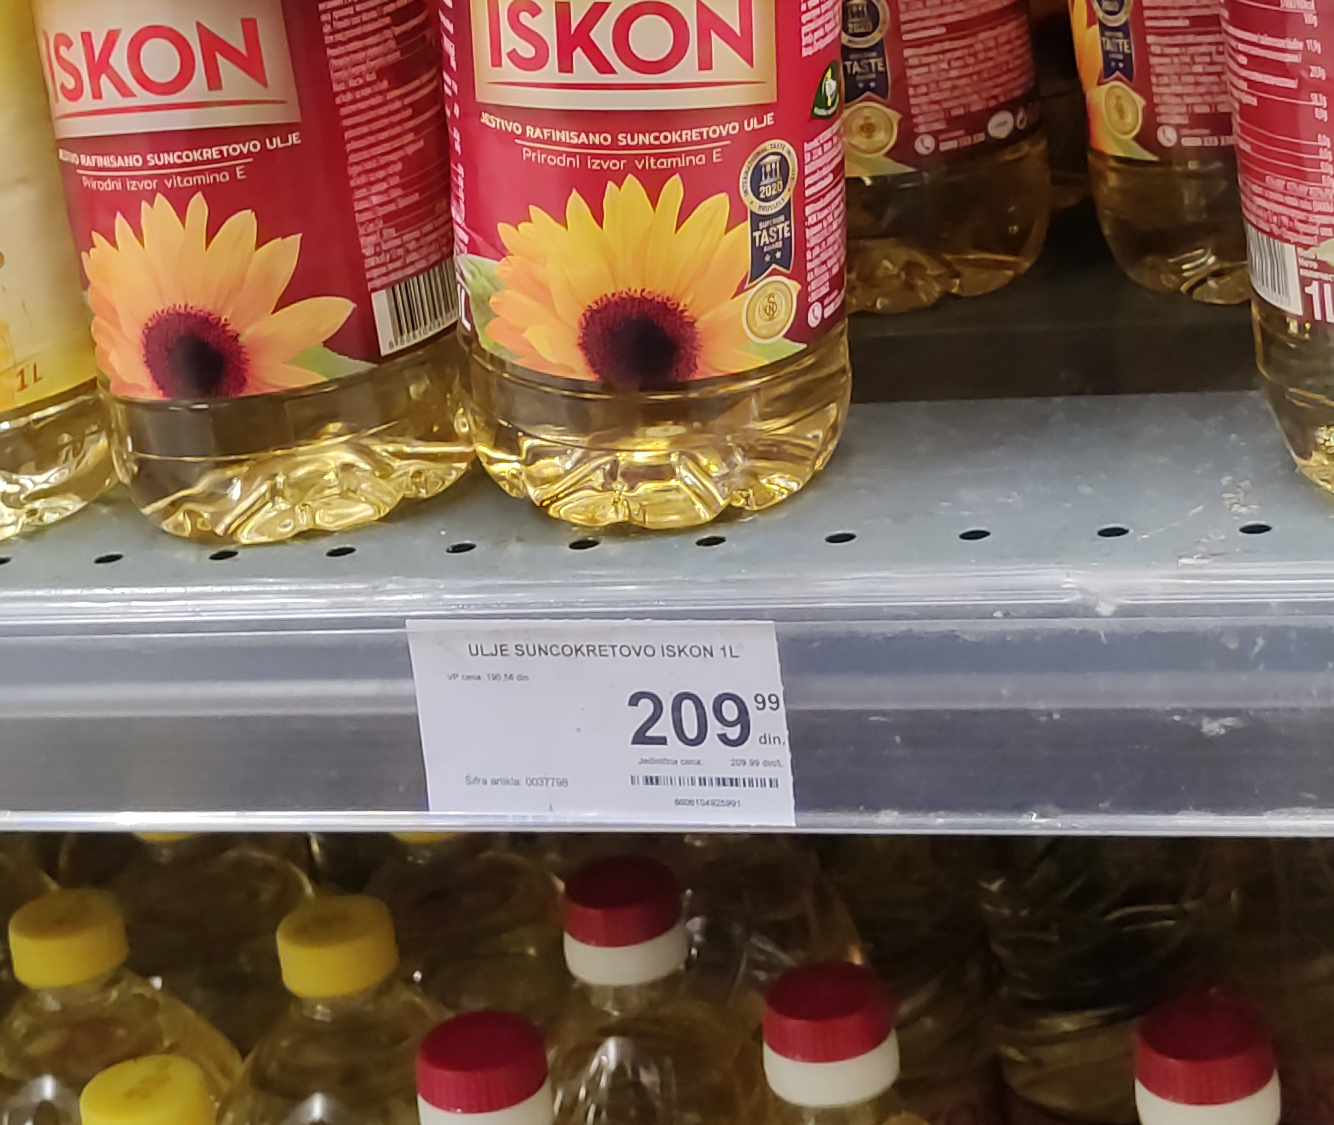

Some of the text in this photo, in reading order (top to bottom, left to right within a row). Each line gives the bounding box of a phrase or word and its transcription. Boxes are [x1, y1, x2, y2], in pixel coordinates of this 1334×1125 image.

[43, 18, 268, 103] ISKON
[844, 58, 885, 75] TASTE
[480, 111, 775, 147] JESTIVO RAFINISANO SUNCOKRETOVO ULJE
[79, 154, 143, 168] RAFINISANO
[147, 140, 261, 166] SUNCOKRETOVO
[266, 132, 302, 150] ULJE
[522, 148, 722, 171] Prirodni izvor vitamina E
[82, 165, 247, 191] Prirodni izvor vitamina E
[759, 181, 783, 198] 2020
[753, 221, 791, 248] TASTE
[468, 643, 740, 658] ULJE SUNCOKRETOVO ISKON 1L
[627, 691, 780, 747] 209 99
